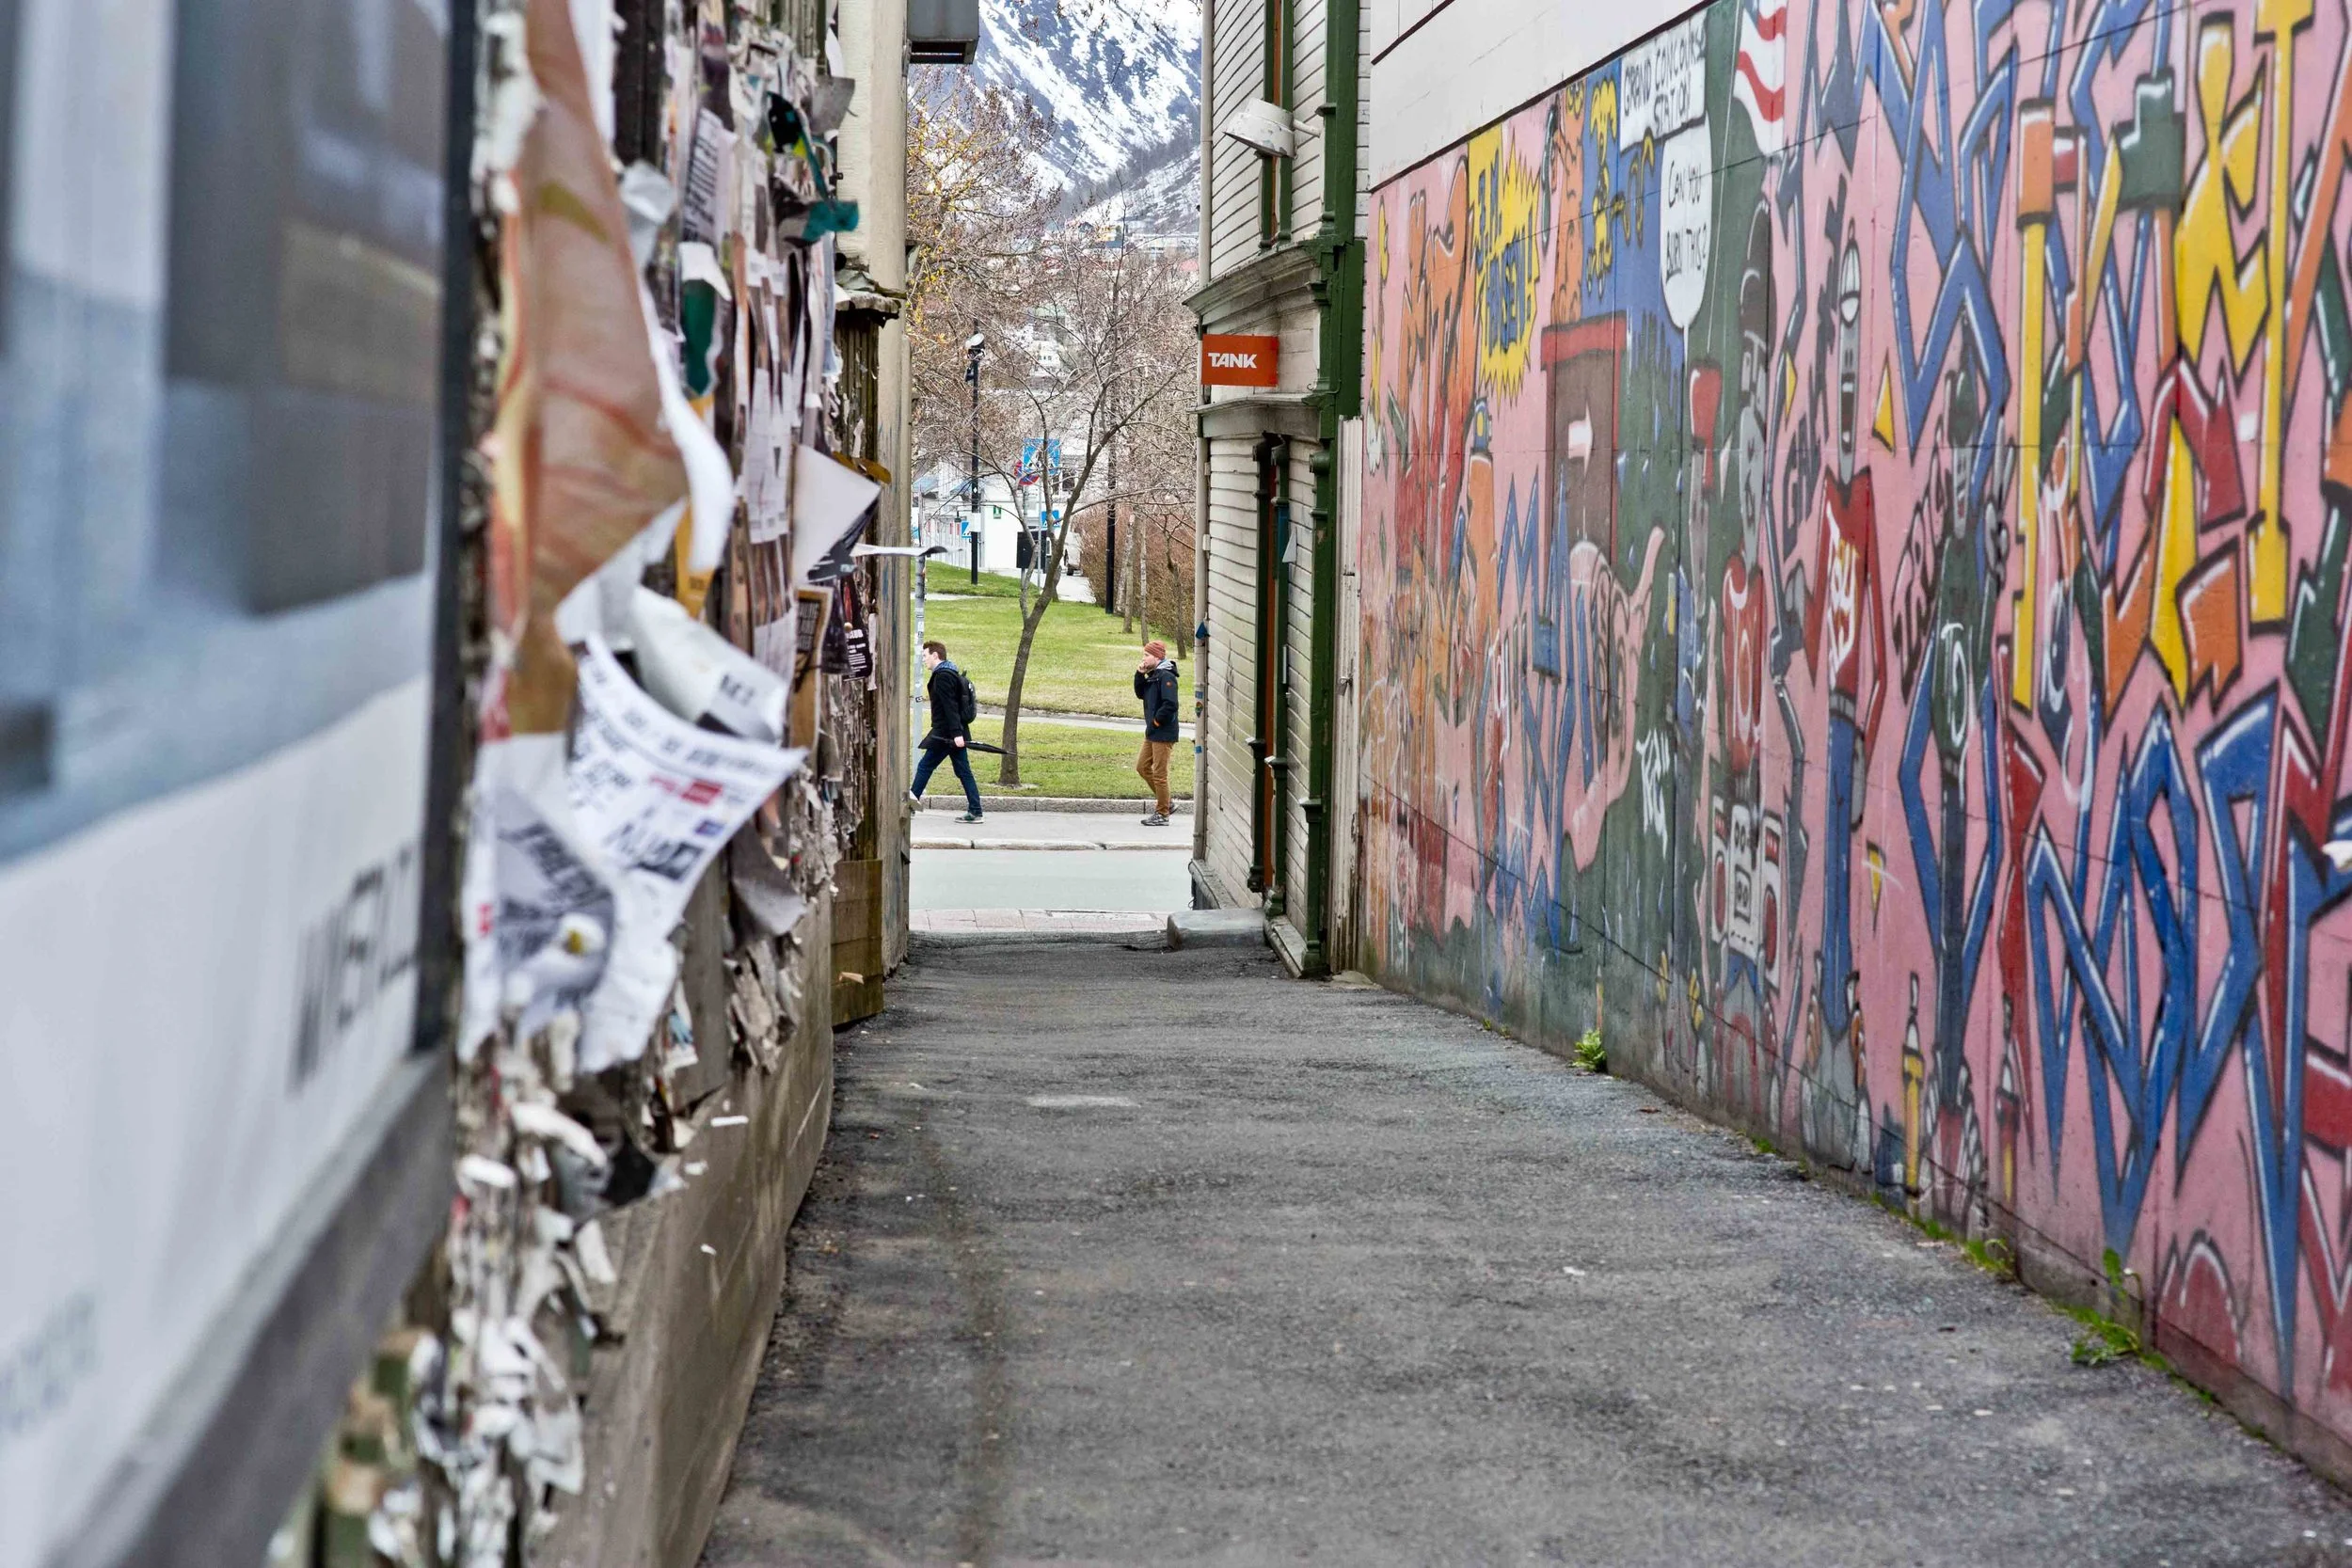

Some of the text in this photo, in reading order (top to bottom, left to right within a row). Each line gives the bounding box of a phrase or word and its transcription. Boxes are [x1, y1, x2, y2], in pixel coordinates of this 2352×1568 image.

[1624, 58, 1652, 118] GRAND
[1654, 71, 1691, 136] STATION
[1207, 352, 1258, 369] TANK
